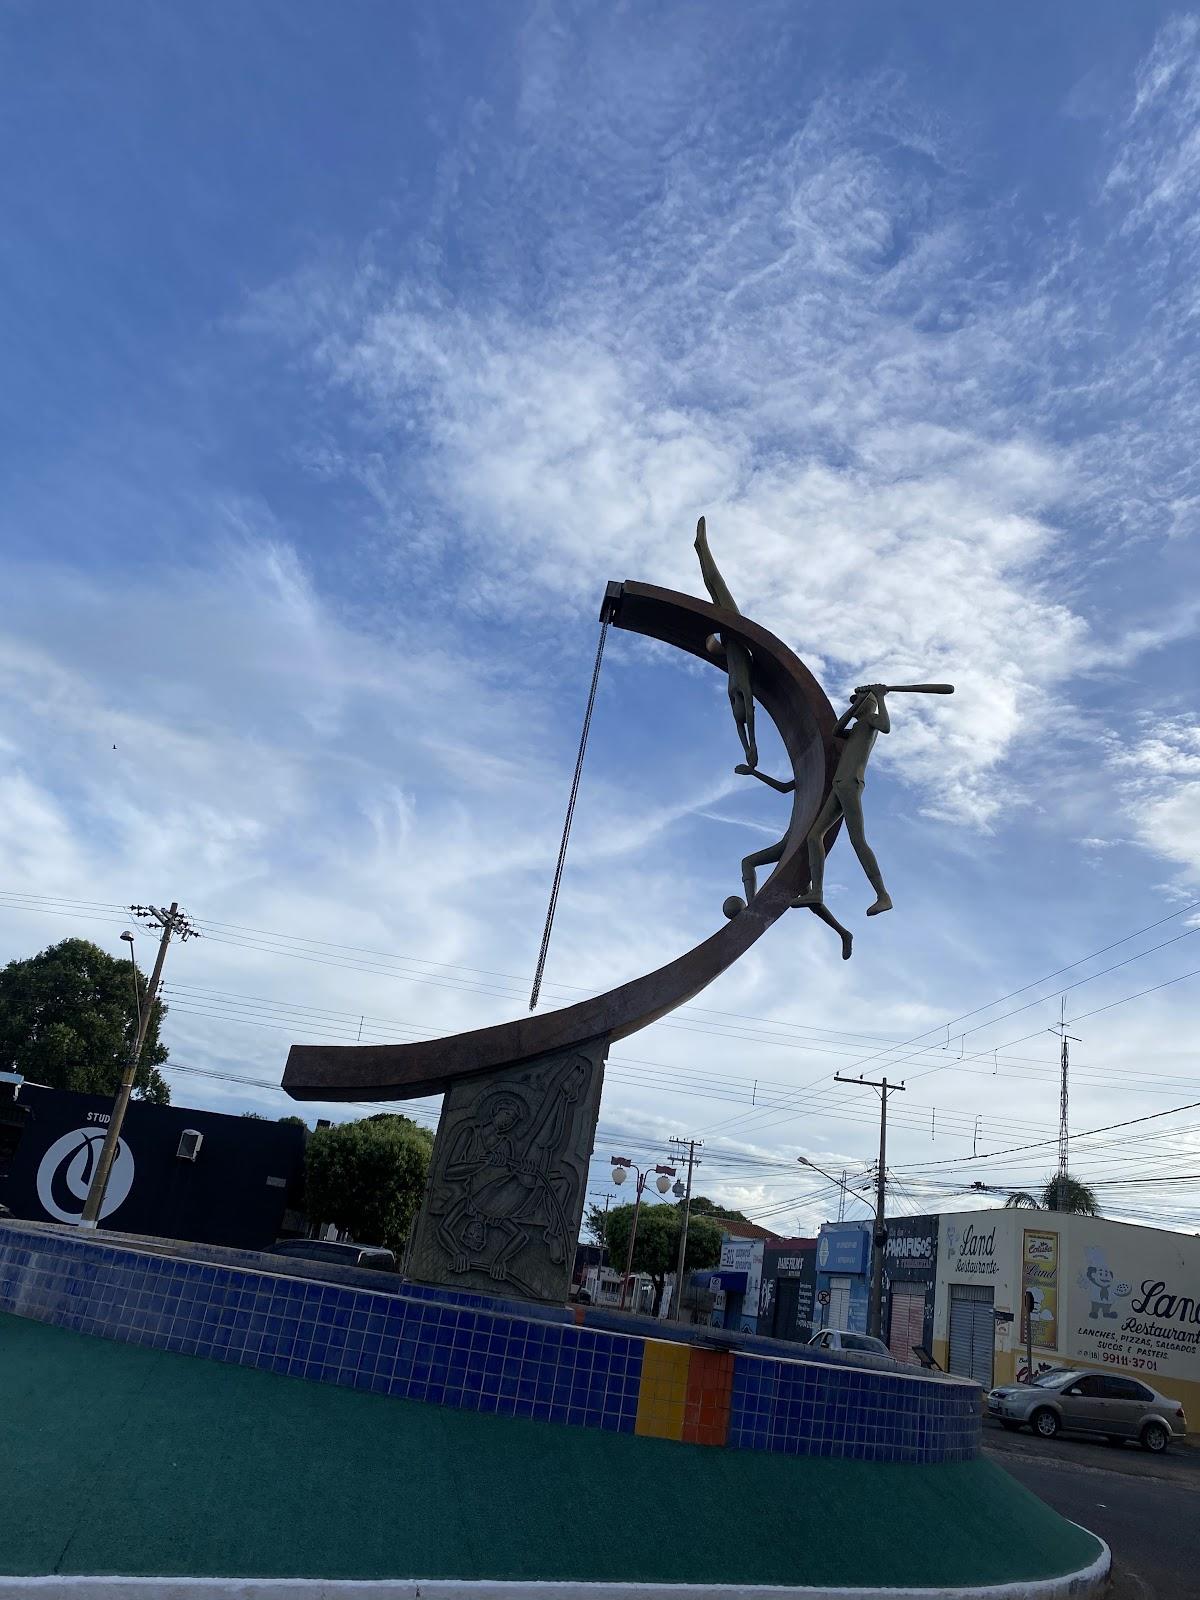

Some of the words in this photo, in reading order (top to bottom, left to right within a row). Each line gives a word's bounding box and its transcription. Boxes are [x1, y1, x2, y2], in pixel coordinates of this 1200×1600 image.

[86, 1111, 111, 1124] STUD
[885, 1236, 932, 1259] PARAFUSOS
[959, 1224, 996, 1257] Land
[955, 1258, 1000, 1275] Restaurante
[1025, 1262, 1057, 1279] Land
[1131, 1279, 1200, 1324] Lan
[1120, 1317, 1200, 1345] Restaurant
[1097, 1340, 1124, 1352] SUCOS
[1155, 1340, 1197, 1354] SALGADOS
